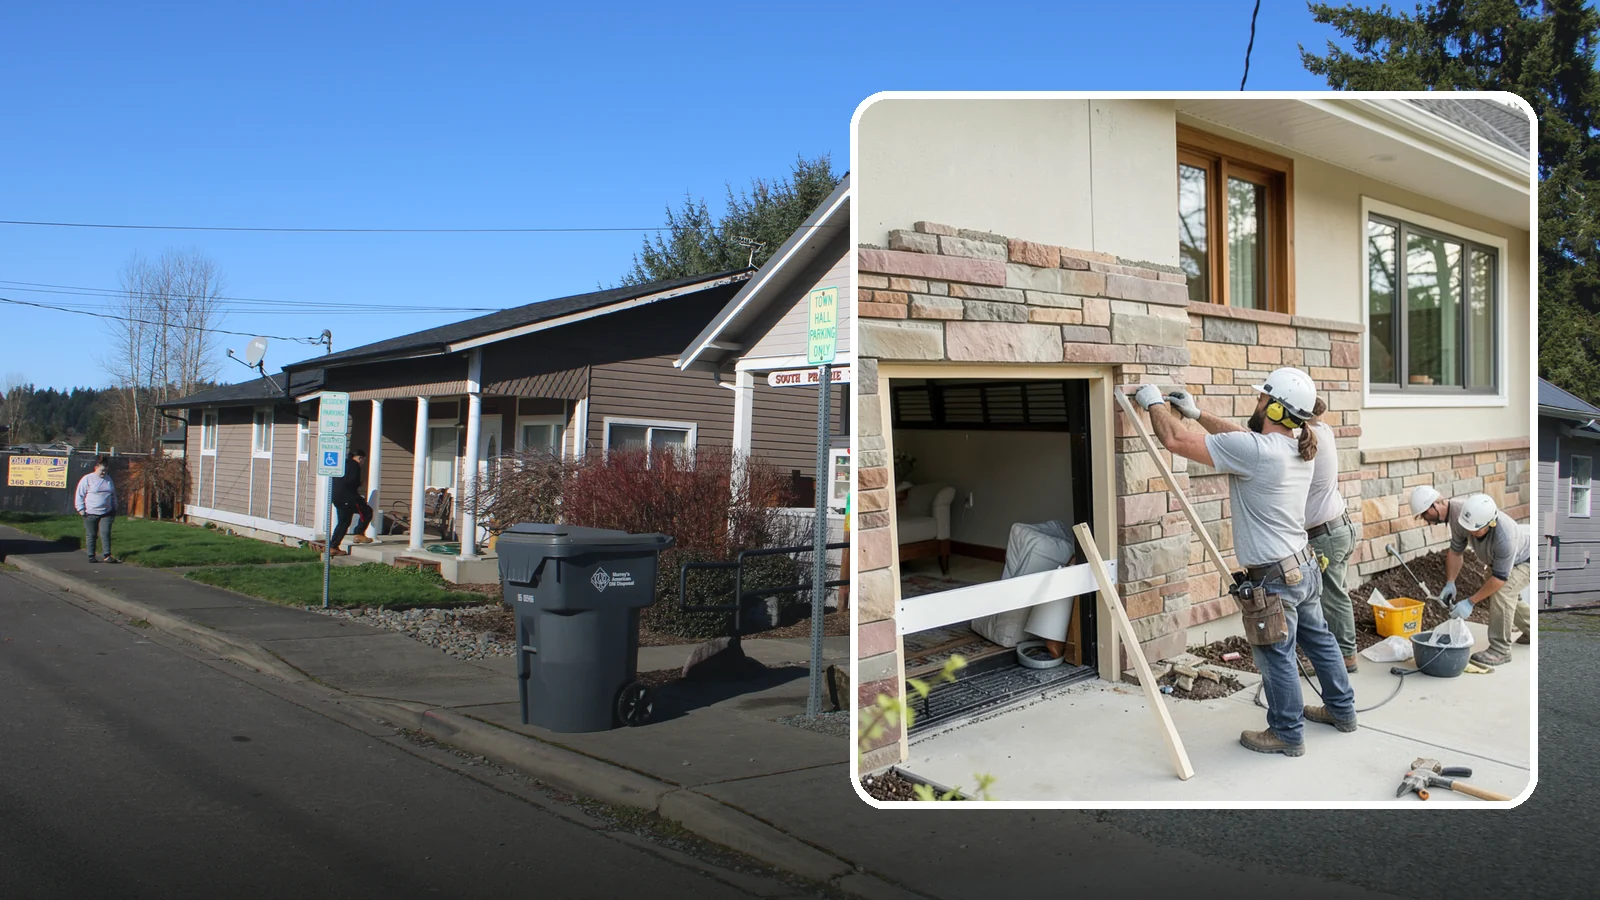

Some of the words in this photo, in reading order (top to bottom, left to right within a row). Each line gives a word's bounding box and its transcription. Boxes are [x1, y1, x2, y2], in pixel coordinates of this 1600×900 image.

[815, 295, 833, 308] TOWN
[814, 311, 831, 324] HALL
[810, 327, 836, 340] PARKING
[813, 344, 831, 357] ONLY
[775, 374, 801, 385] SOUTH
[807, 371, 842, 383] PRIE
[325, 420, 340, 428] ONLY
